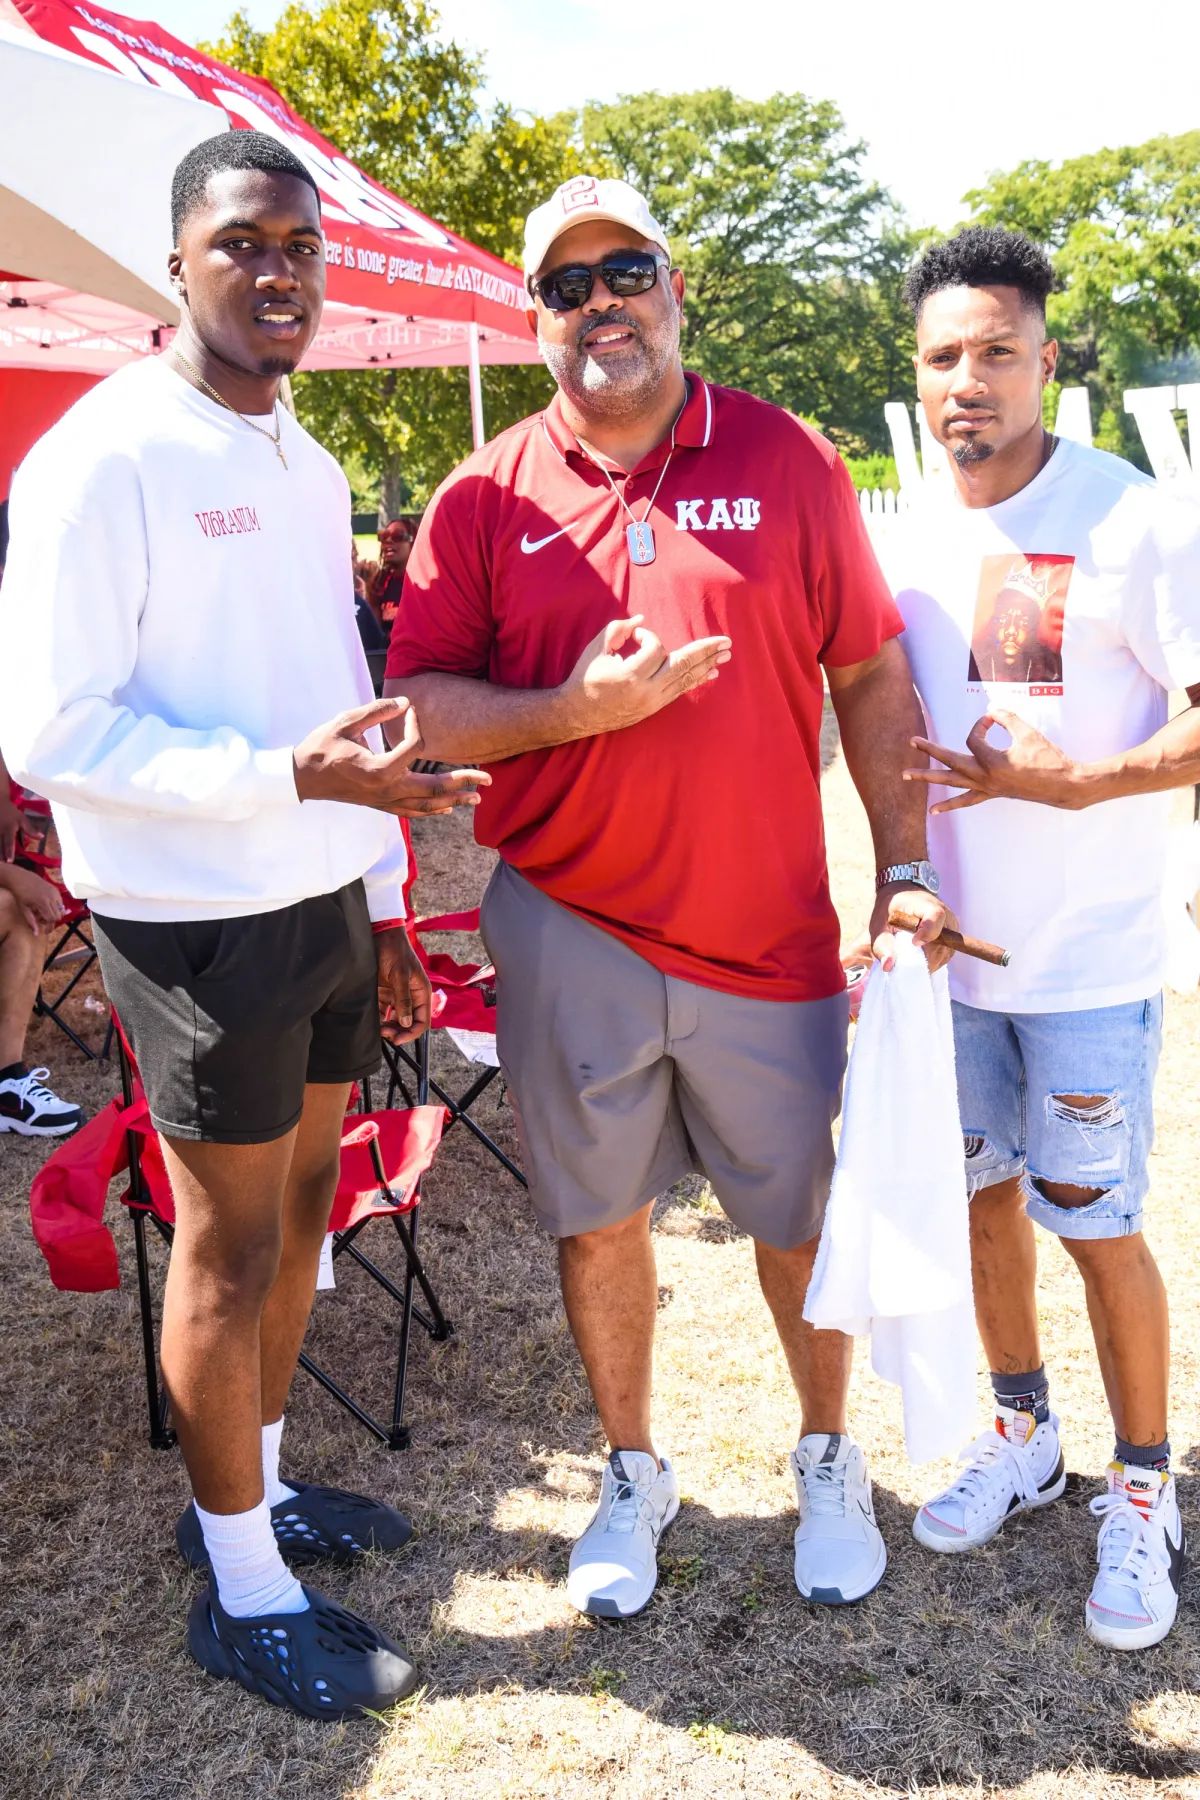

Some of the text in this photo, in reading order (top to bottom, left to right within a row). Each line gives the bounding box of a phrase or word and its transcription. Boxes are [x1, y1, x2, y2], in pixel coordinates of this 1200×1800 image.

[344, 236, 355, 268] is
[357, 248, 386, 275] none
[1031, 687, 1061, 695] BIG
[1129, 1479, 1151, 1490] NIKE
